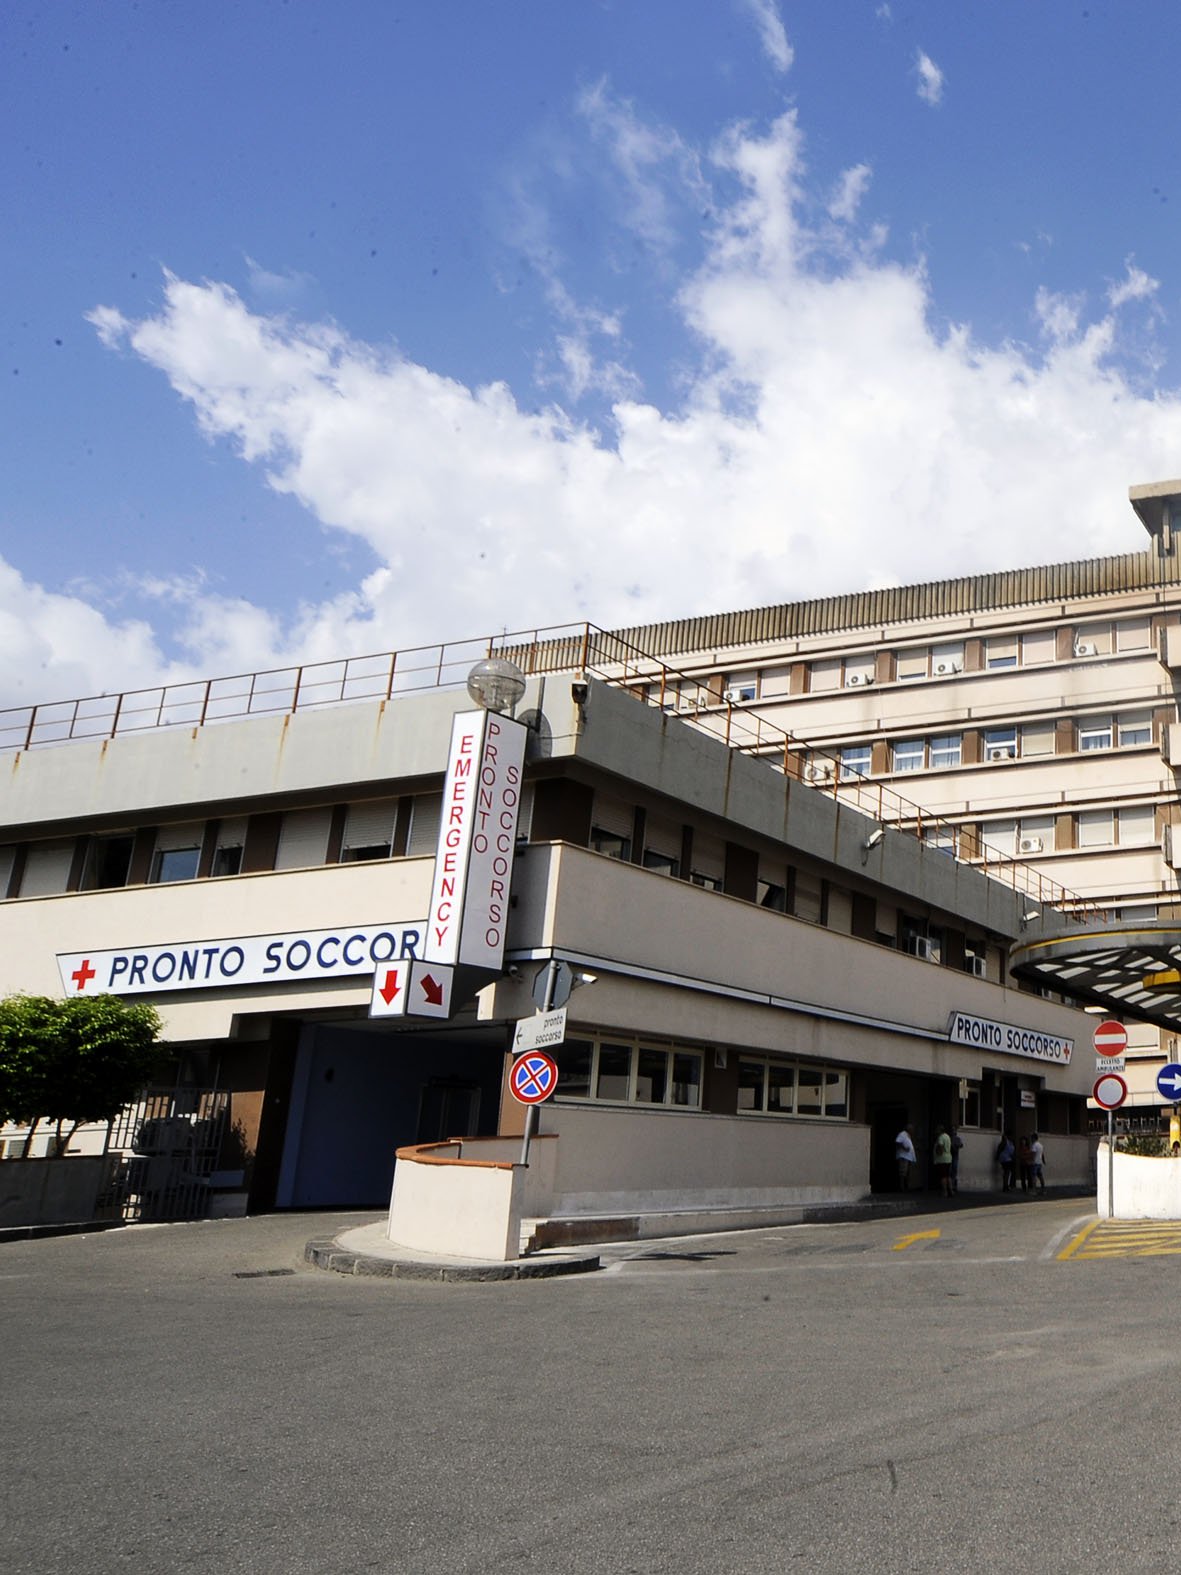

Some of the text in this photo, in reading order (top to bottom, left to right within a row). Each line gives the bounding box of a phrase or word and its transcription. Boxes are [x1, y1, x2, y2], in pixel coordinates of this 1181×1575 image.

[474, 722, 501, 854] PRONTO
[434, 735, 474, 947] EMERGENCY
[485, 765, 519, 948] SOCCORSO
[108, 929, 420, 987] PRONTO SOCCOR
[535, 1030, 562, 1045] soccorso
[543, 1014, 563, 1030] pronto
[957, 1016, 1061, 1059] PRONTO SOCCORSO
